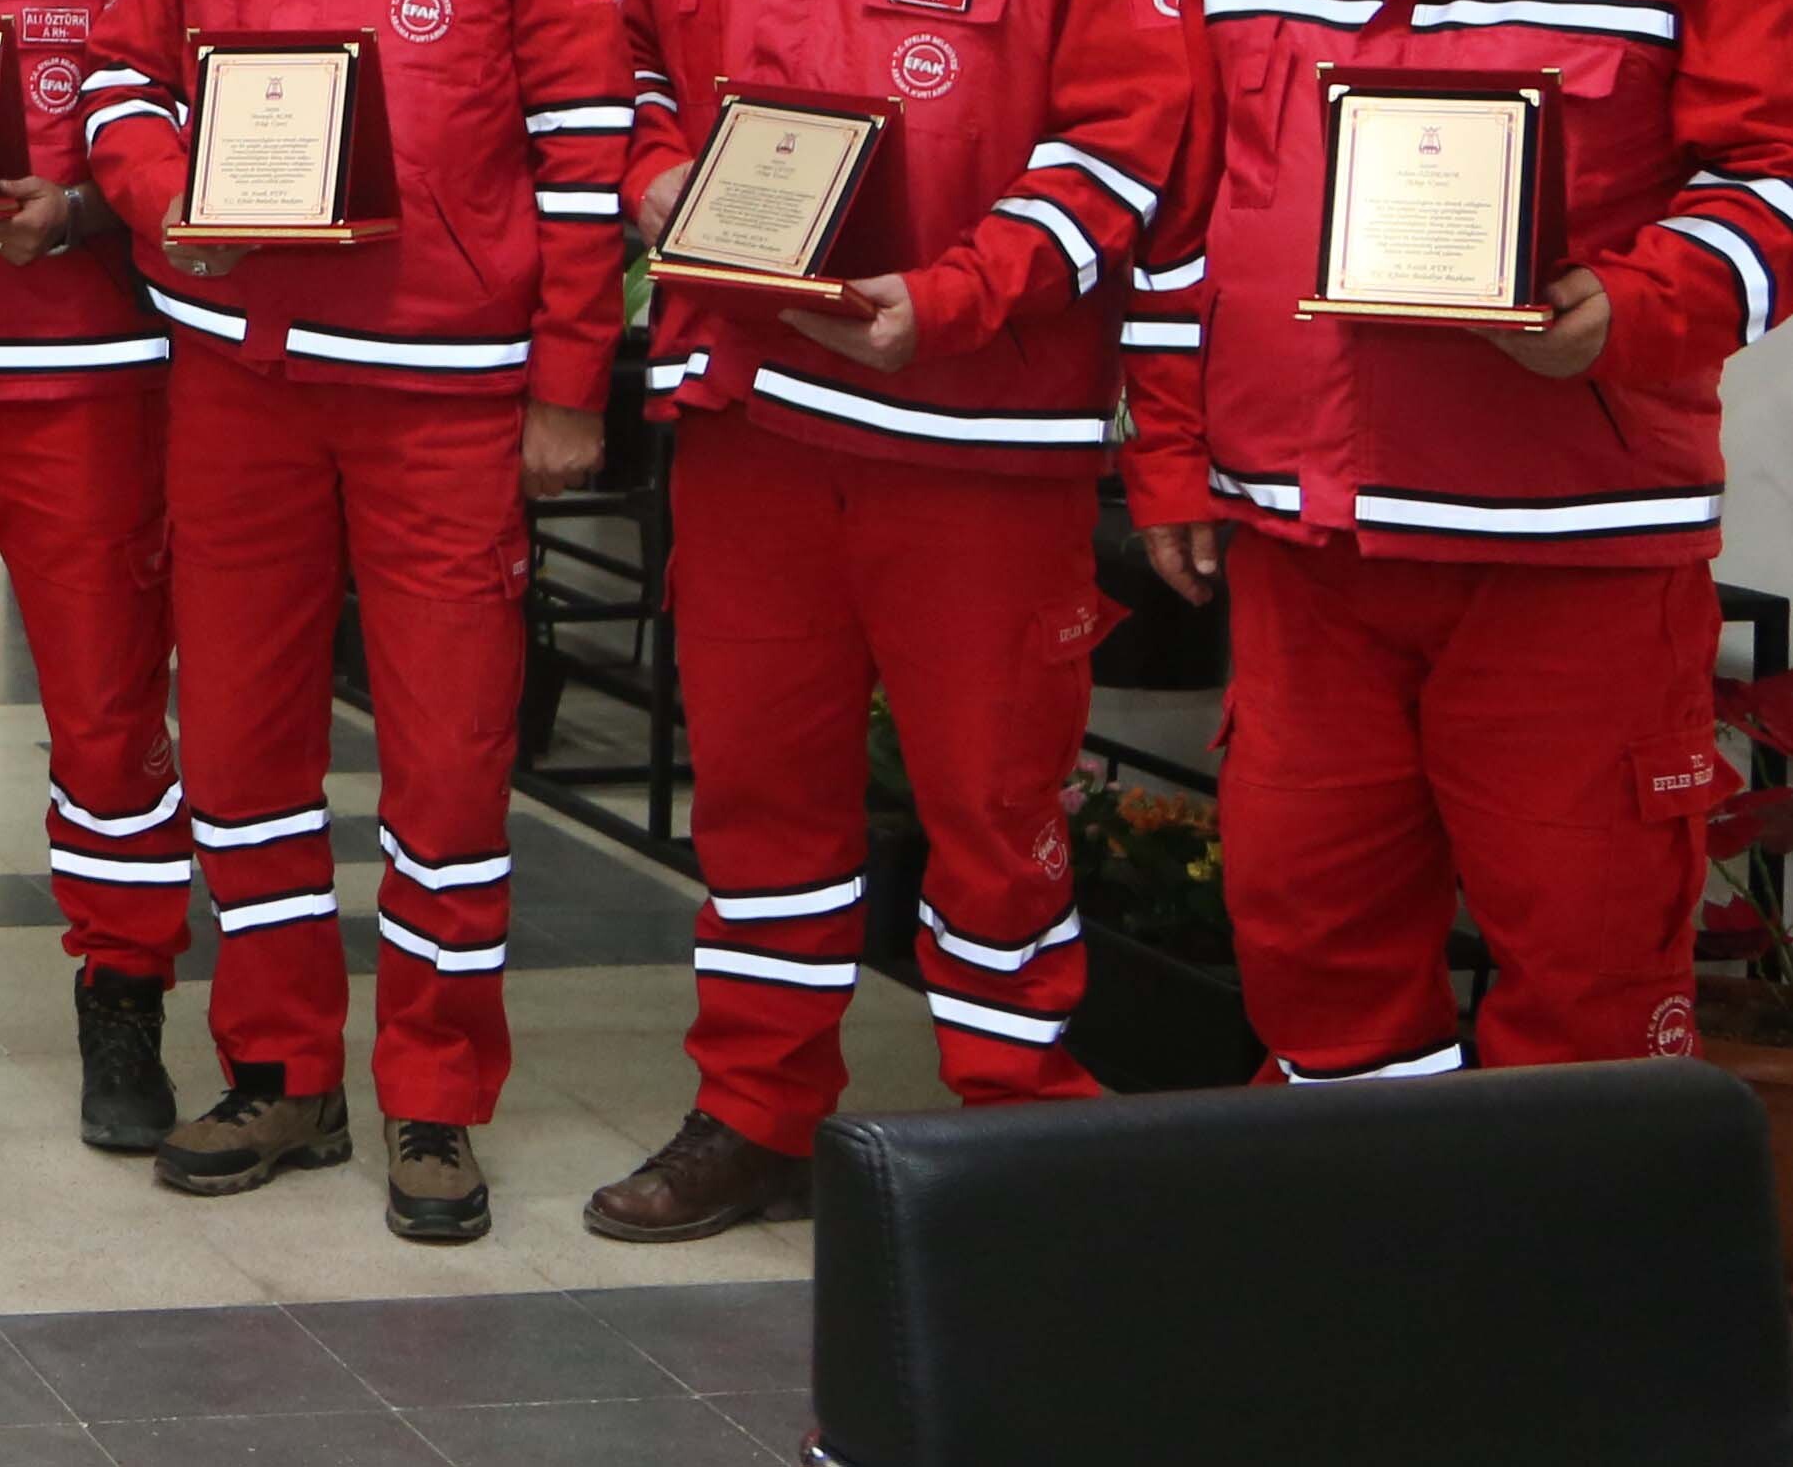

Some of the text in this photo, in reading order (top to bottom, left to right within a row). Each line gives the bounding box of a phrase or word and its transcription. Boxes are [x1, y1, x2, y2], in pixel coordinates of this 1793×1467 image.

[44, 12, 86, 26] ÖZTÜRK
[402, 3, 440, 20] EFAK
[43, 27, 50, 38] A
[904, 56, 944, 75] EFAK
[40, 78, 72, 93] EFAK
